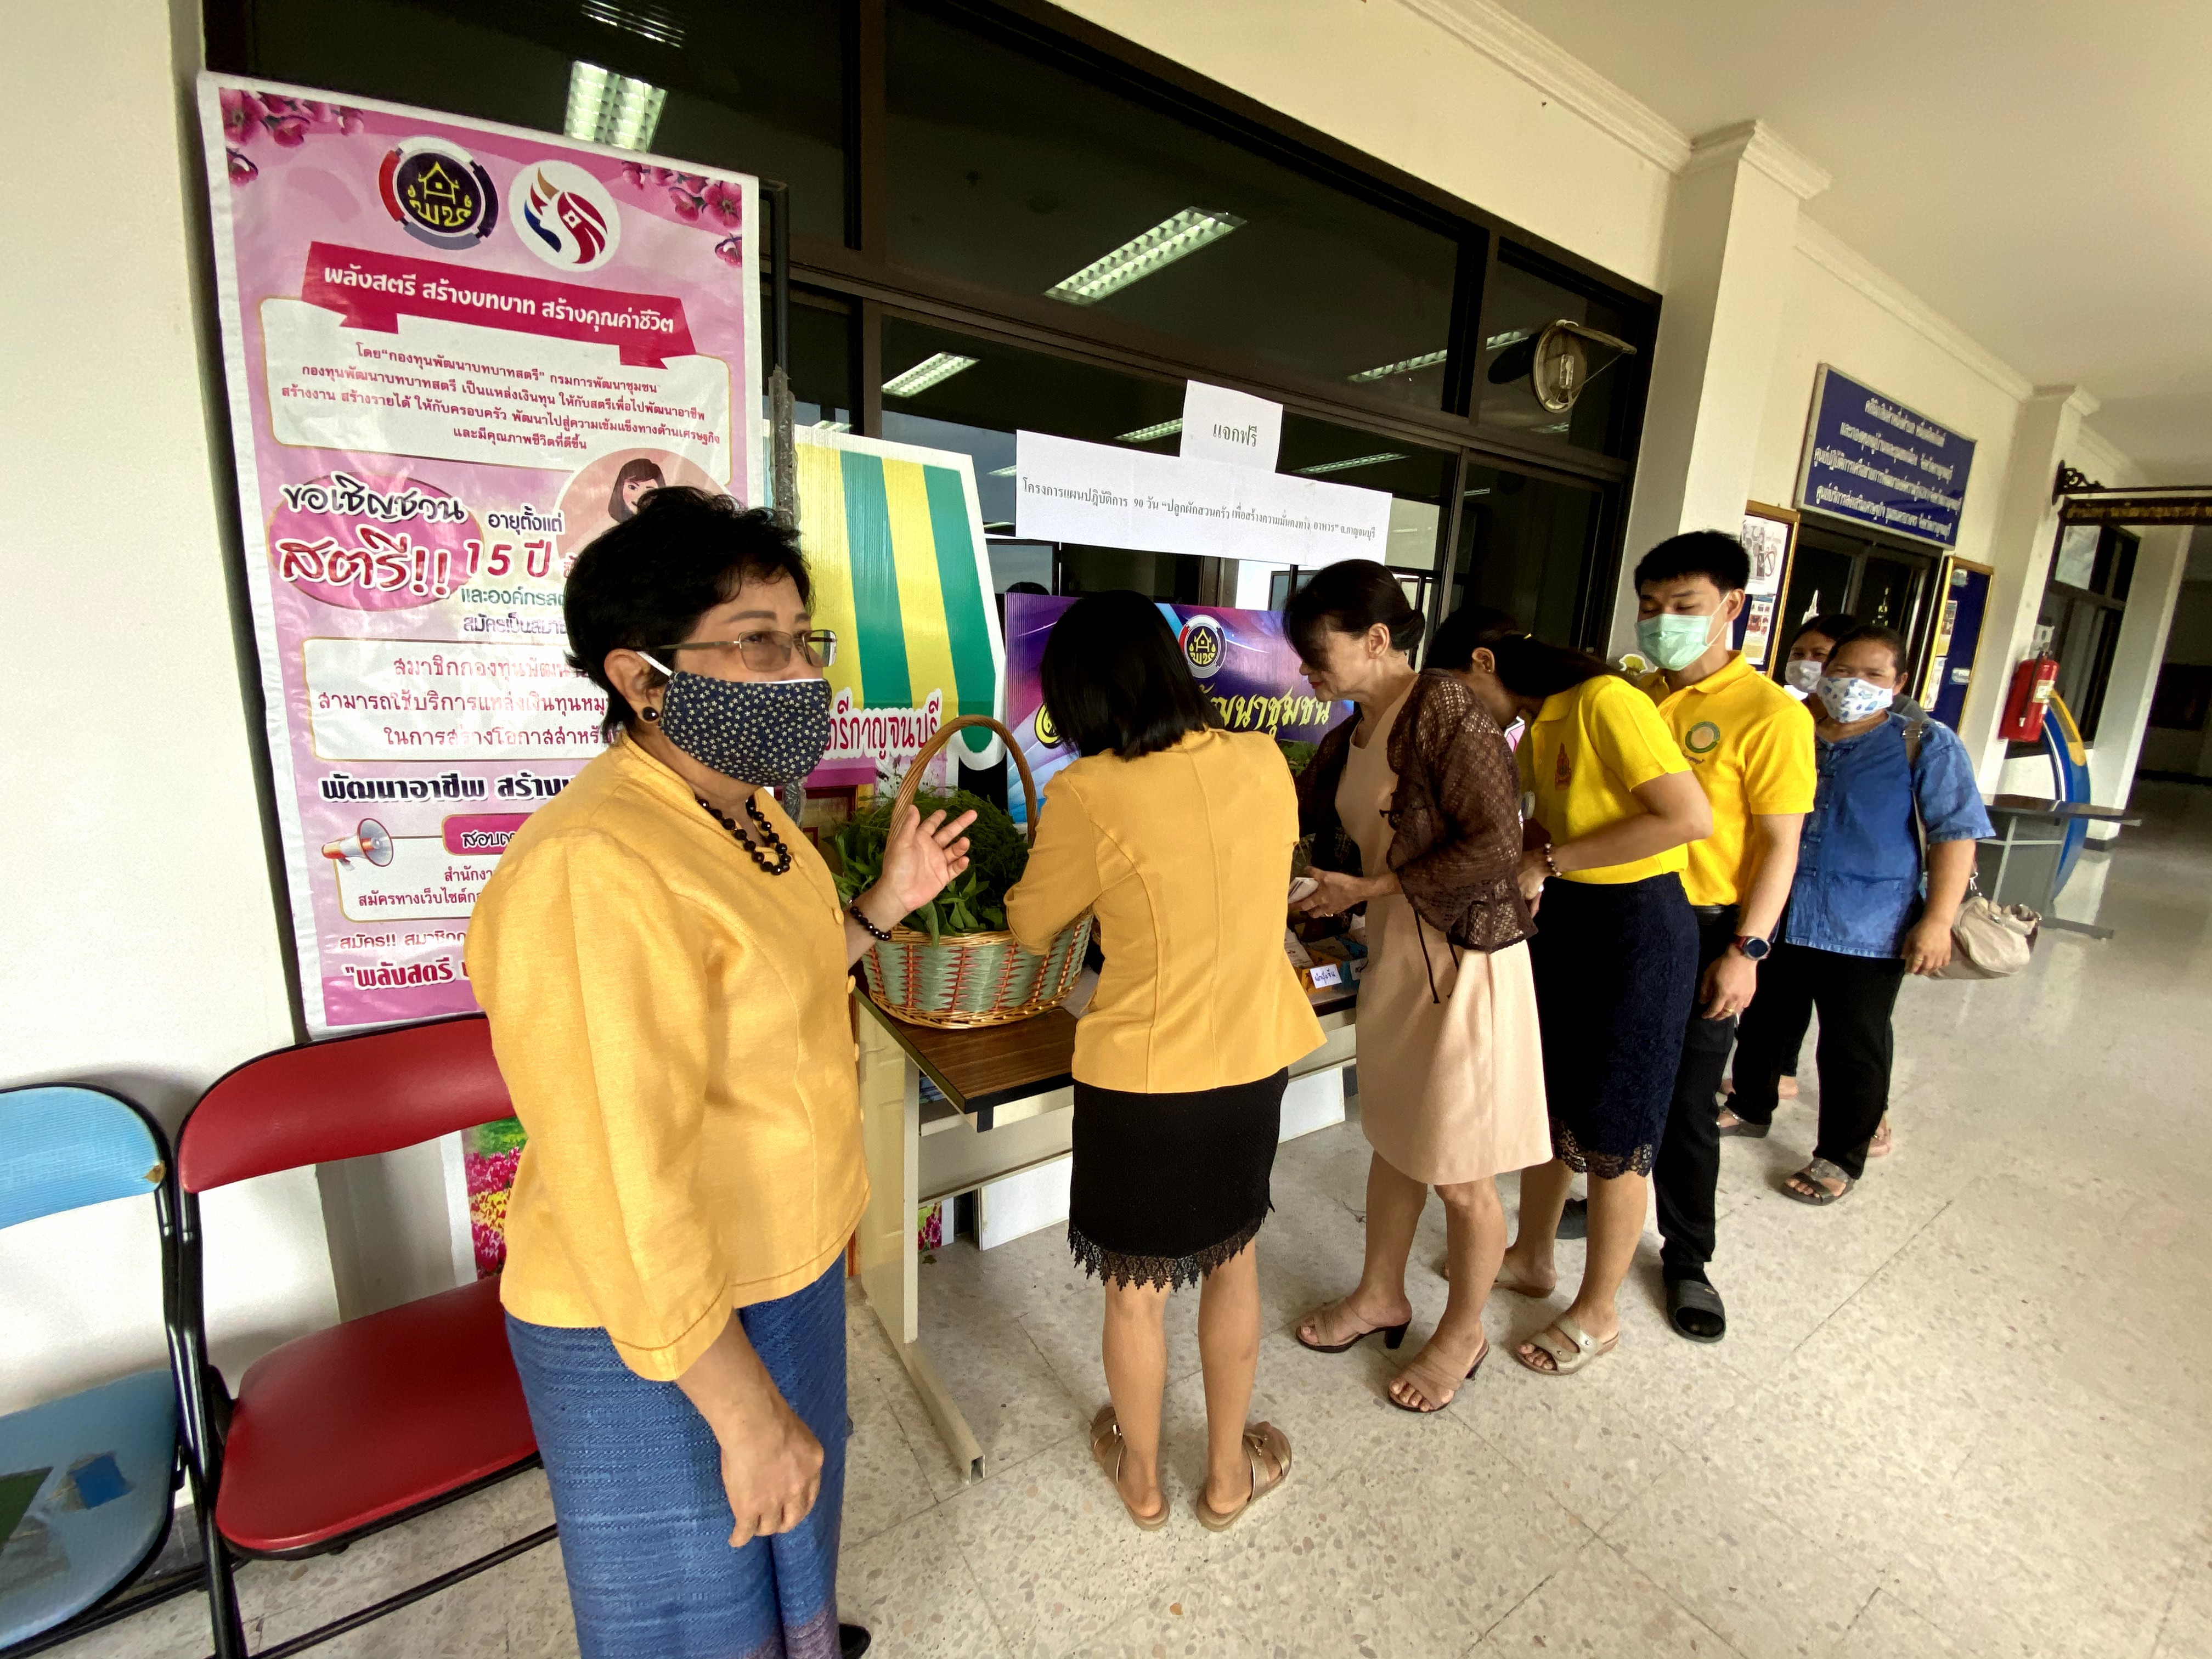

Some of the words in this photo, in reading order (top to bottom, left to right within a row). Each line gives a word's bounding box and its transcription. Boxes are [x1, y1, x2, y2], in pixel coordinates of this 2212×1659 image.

[324, 263, 416, 296] พลังสตรี
[422, 278, 535, 315] สร้างบทบาท
[541, 297, 674, 334] สร้างคุณค่าชีวิต
[302, 364, 456, 392] กองทุนพัฒนาบทบาทสตรี
[462, 380, 556, 408] เป็นแหล่งเงินทุน
[558, 391, 705, 421] ให้กับสตรีเพื่อไปพัฒนาอาชีพ
[550, 374, 658, 395] กรมการพัฒนาชุมชน
[281, 383, 336, 402] สร้างงาน
[341, 390, 411, 409] สร้างรายได้
[414, 395, 507, 420] ให้กับครอบครัว
[512, 409, 720, 445] พัฒนาไปสู่ความเข้มแข็งทางด้านเศรษฐกิจ
[453, 427, 587, 450] และมีคุณภาพชีวิตที่ดีขึ้น
[1212, 422, 1258, 447] แจกฟรี
[283, 474, 465, 520] ขอเชิญชวน
[1023, 477, 1128, 506] โครงการแผนปฏิบัติการ
[1133, 498, 1143, 508] 90
[1147, 495, 1159, 510] วัน
[1161, 498, 1230, 520] “ปลูกผักสวนครัว
[1340, 526, 1376, 541] จ.กาญจนบุรี
[488, 505, 562, 535] อายุตั้งแต่
[279, 527, 447, 595] สตรี!!
[467, 542, 512, 576] 15
[524, 539, 552, 578] ปี
[318, 689, 610, 716] สามารถใช้บริการแหล่งเงินทุนหมุ
[321, 773, 485, 800] พัฒนาอาชีพ
[497, 771, 574, 798] สร้าง
[462, 831, 515, 847] สอบถ
[358, 886, 481, 906] สมัครทางเว็บไซต์ก
[340, 933, 396, 950] สมัคร!!
